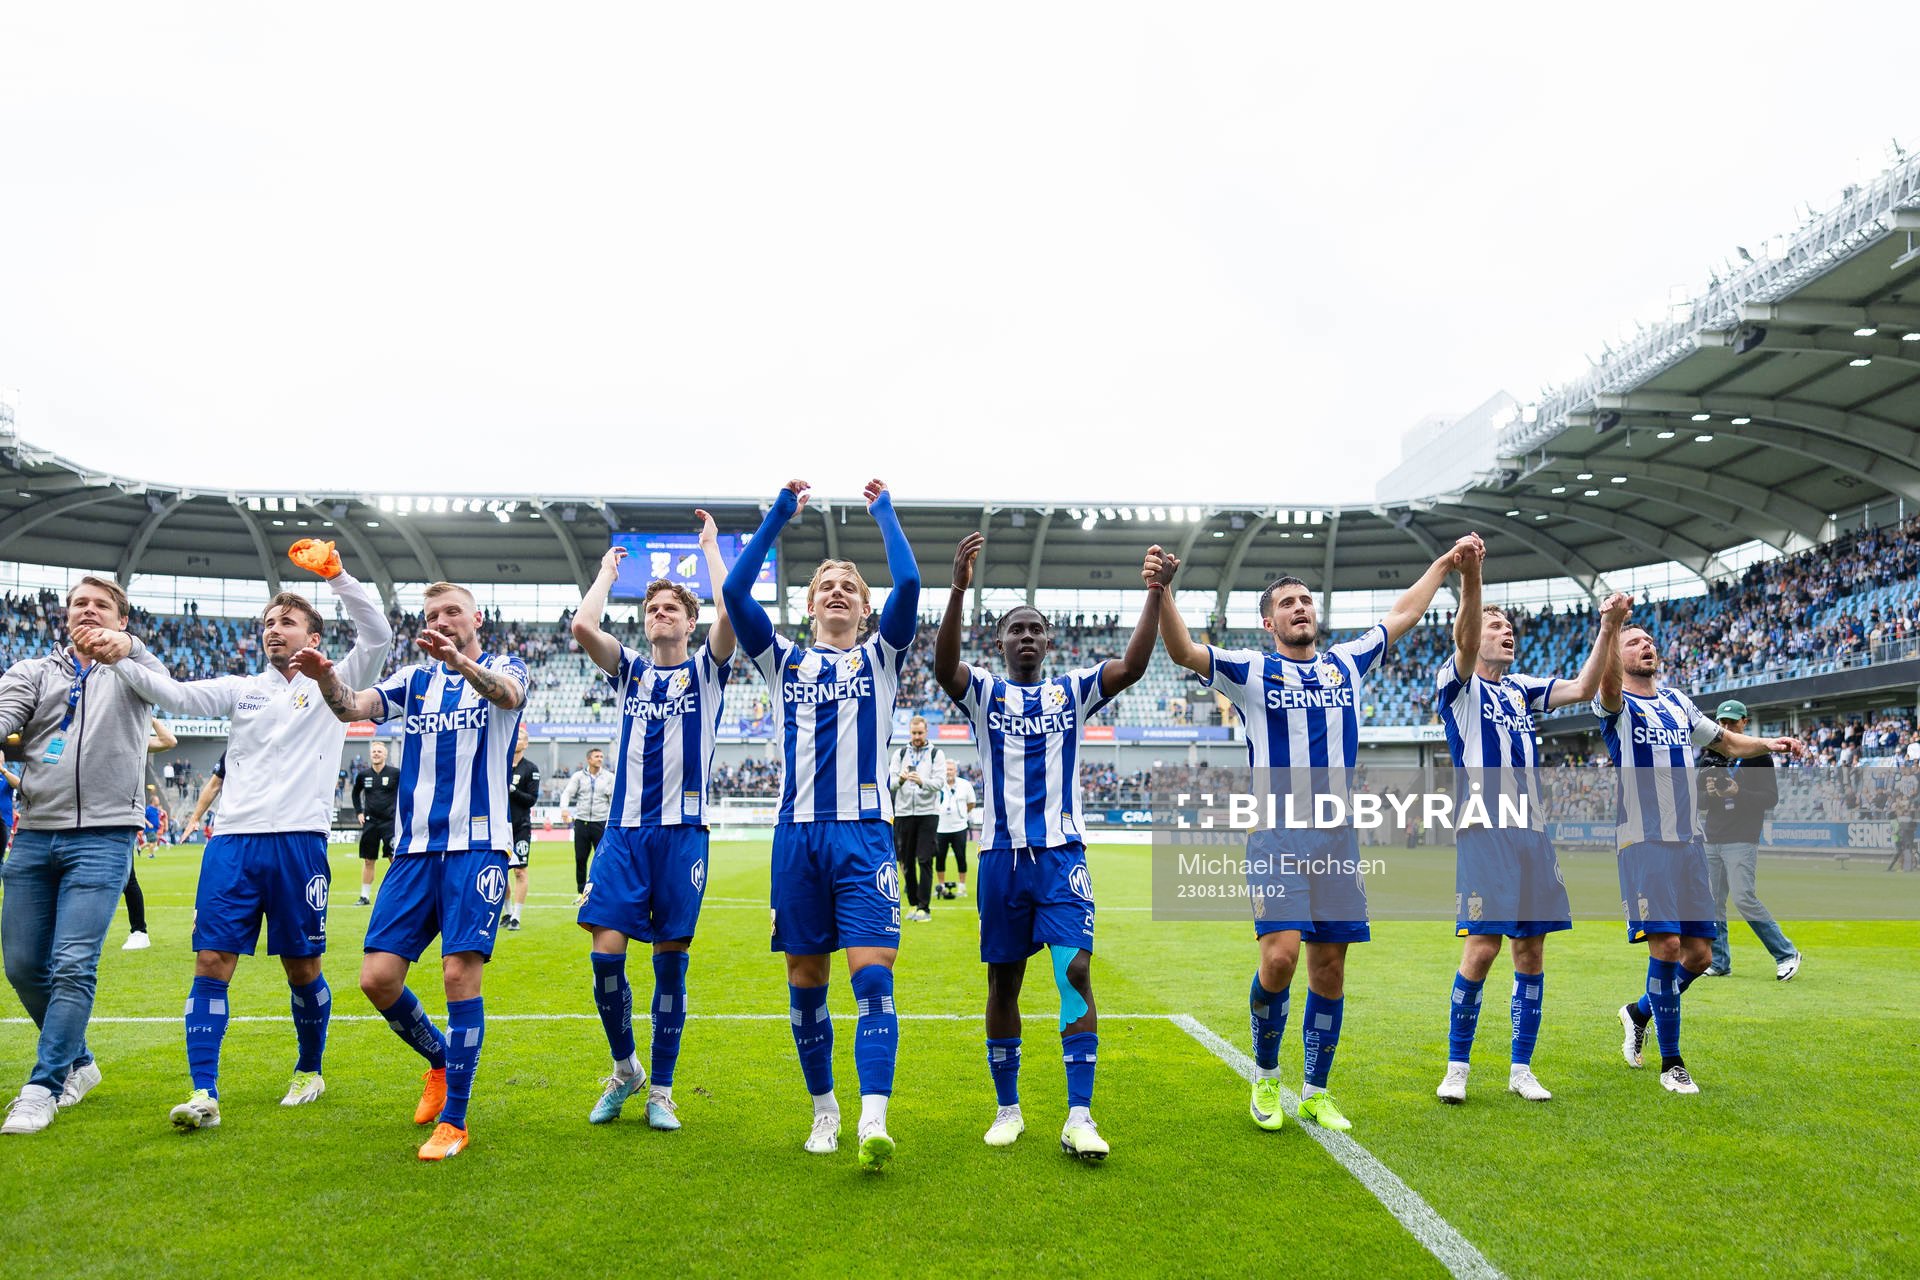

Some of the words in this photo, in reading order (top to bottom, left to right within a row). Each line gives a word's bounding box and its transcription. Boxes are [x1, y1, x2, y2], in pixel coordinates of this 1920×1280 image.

[784, 676, 871, 703] SERNEKE
[1267, 688, 1352, 709] SERNEKE
[624, 692, 695, 720] SERNEKE
[405, 708, 487, 735] SERNEKE
[988, 710, 1073, 735] SERNEKE
[1633, 726, 1691, 744] SERNEK
[1121, 811, 1171, 823] CRAFT
[309, 877, 327, 908] MG
[479, 867, 505, 902] MG
[486, 912, 494, 928] 7
[188, 1025, 212, 1033] IFK
[864, 1027, 889, 1037] IFK
